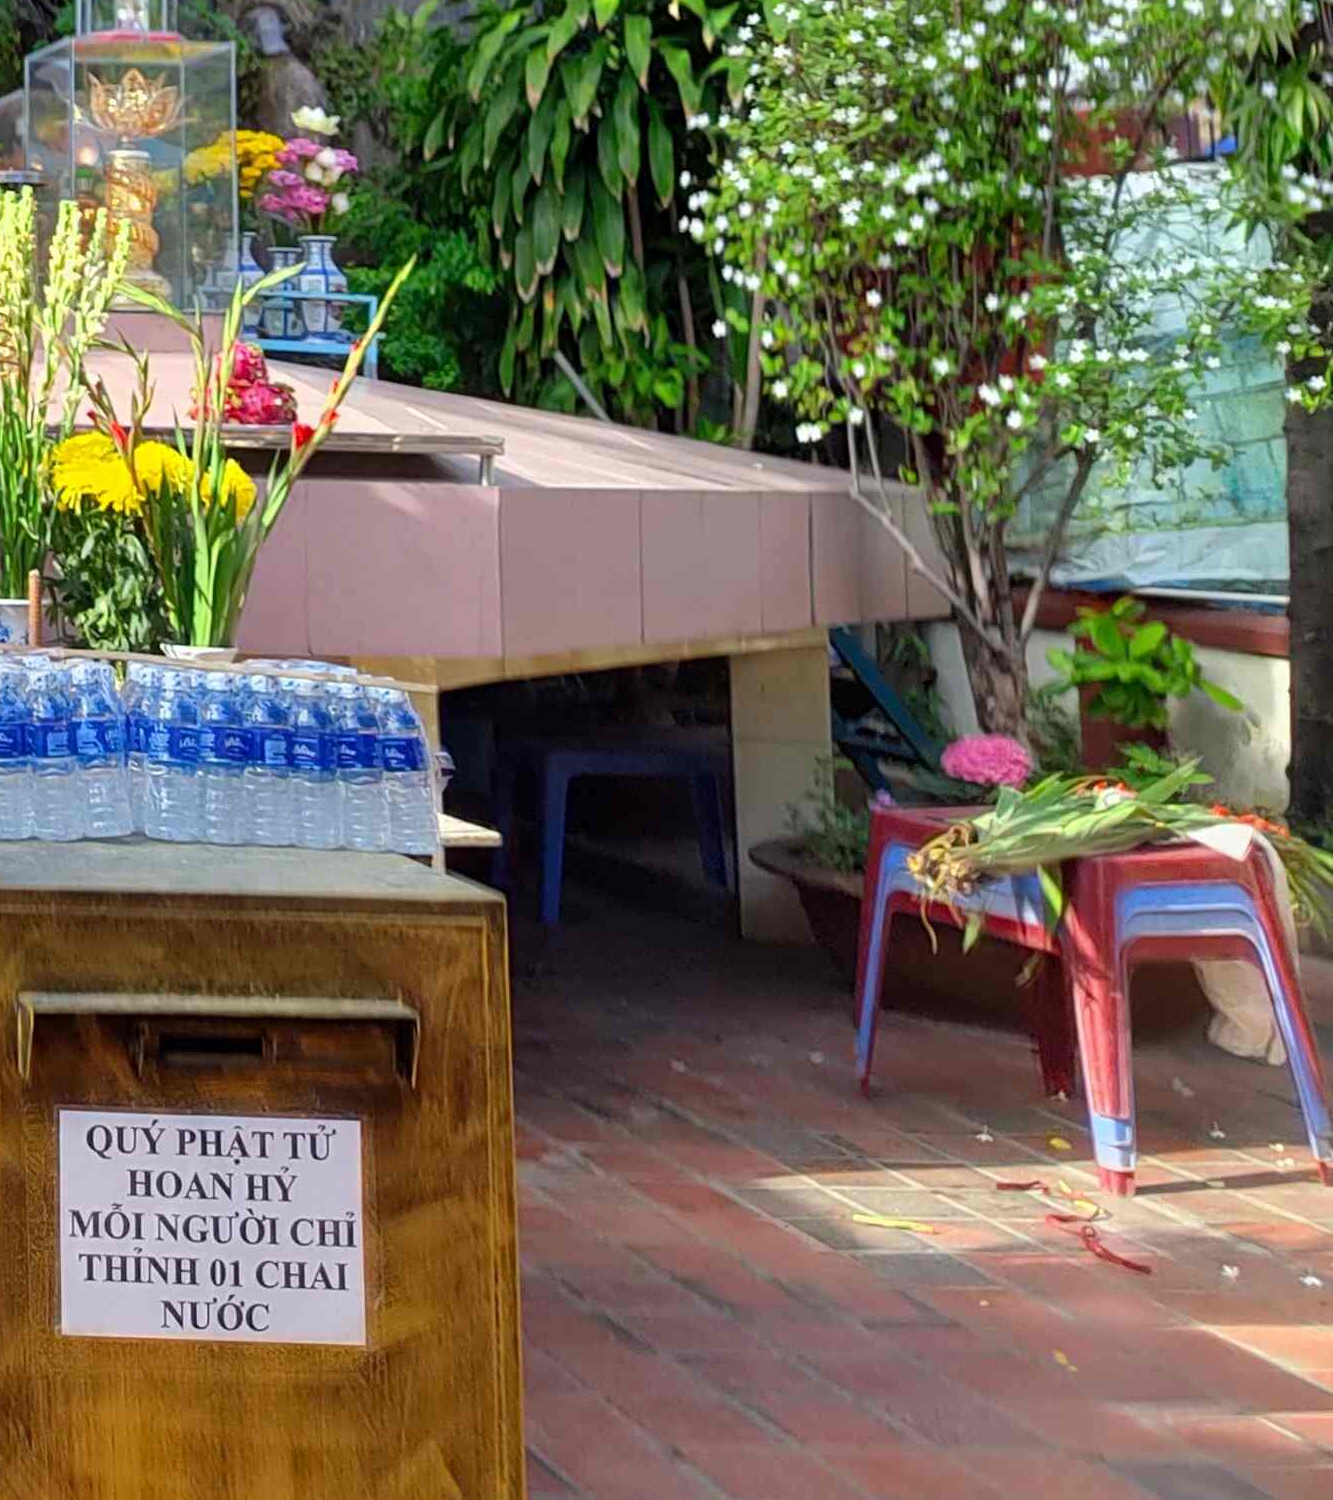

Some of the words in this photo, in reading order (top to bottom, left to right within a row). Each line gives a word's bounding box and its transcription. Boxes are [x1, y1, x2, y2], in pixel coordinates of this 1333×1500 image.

[86, 1119, 165, 1159] QUÝ
[175, 1126, 274, 1166] PHẬT
[283, 1124, 337, 1161] TỬ
[127, 1168, 233, 1200] HOAN
[245, 1166, 298, 1202] HỶ
[68, 1202, 146, 1240] MỖI
[156, 1208, 280, 1246] NGƯỜI
[290, 1211, 358, 1248] CHỈ
[78, 1247, 200, 1286] THỈNH
[209, 1258, 244, 1288] 01
[255, 1260, 350, 1291] CHAI
[160, 1294, 270, 1332] NƯỚC
